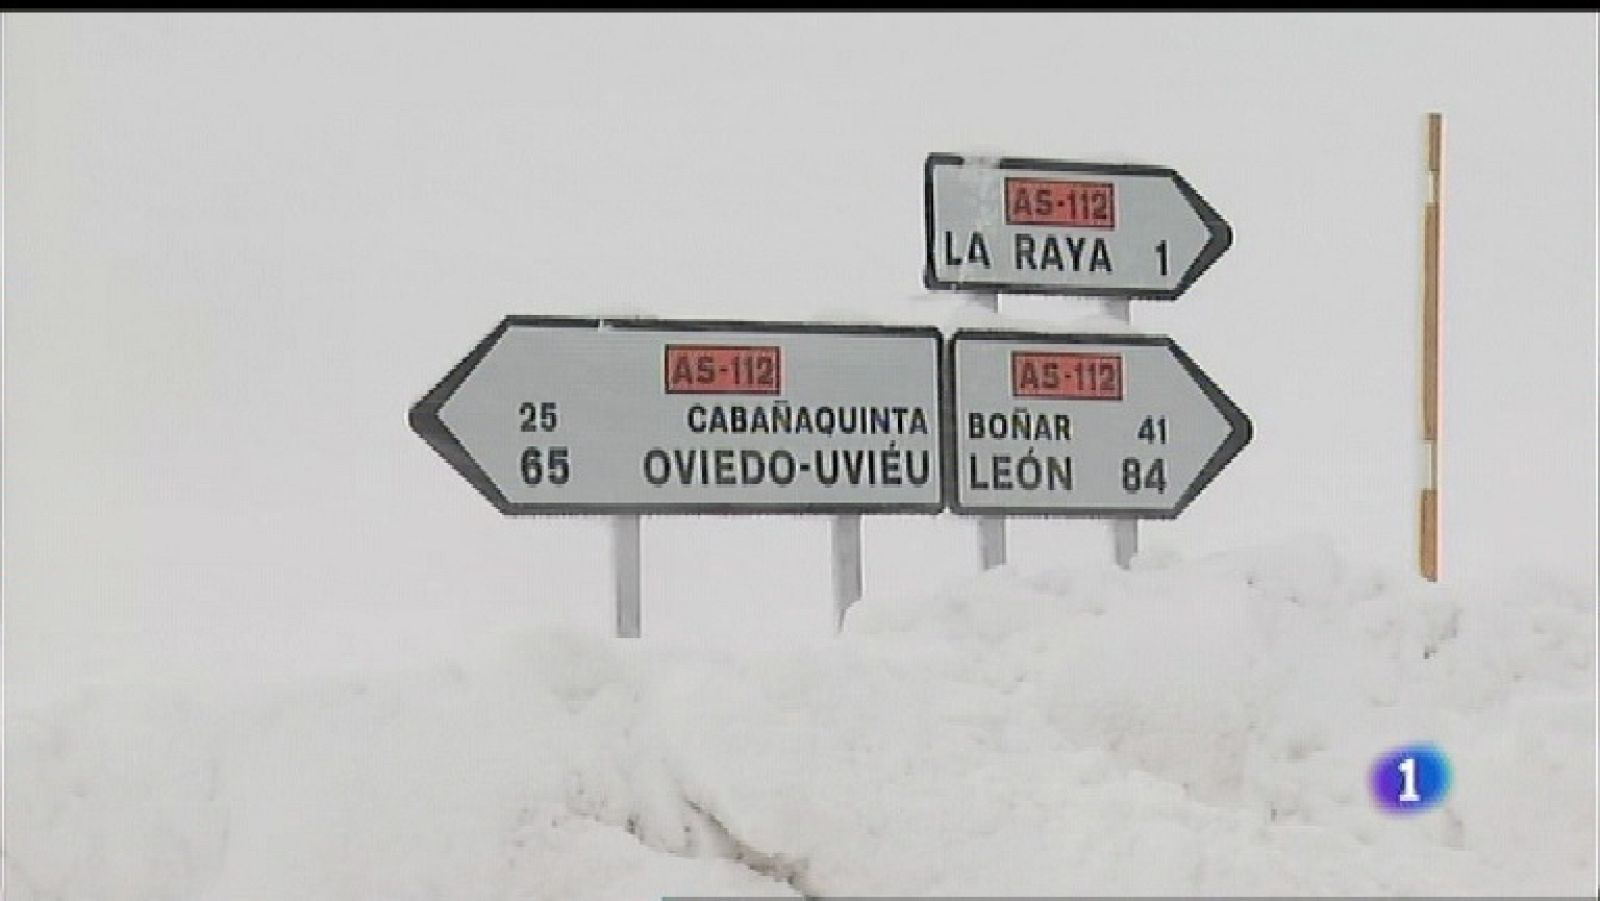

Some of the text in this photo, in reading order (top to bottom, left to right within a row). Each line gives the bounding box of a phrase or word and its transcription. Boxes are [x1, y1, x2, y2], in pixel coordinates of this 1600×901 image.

[1012, 188, 1108, 220] AS-112
[945, 231, 1168, 276] LA RAYA 1
[671, 356, 776, 386] AS-112
[1019, 362, 1116, 391] AS-112
[519, 401, 928, 435] 25 CABAÑAQUINTA
[968, 407, 1166, 444] BOÑAR 41
[520, 440, 930, 487] 65 OVIEDO-UVIÉU
[970, 446, 1167, 494] LEÓN 84
